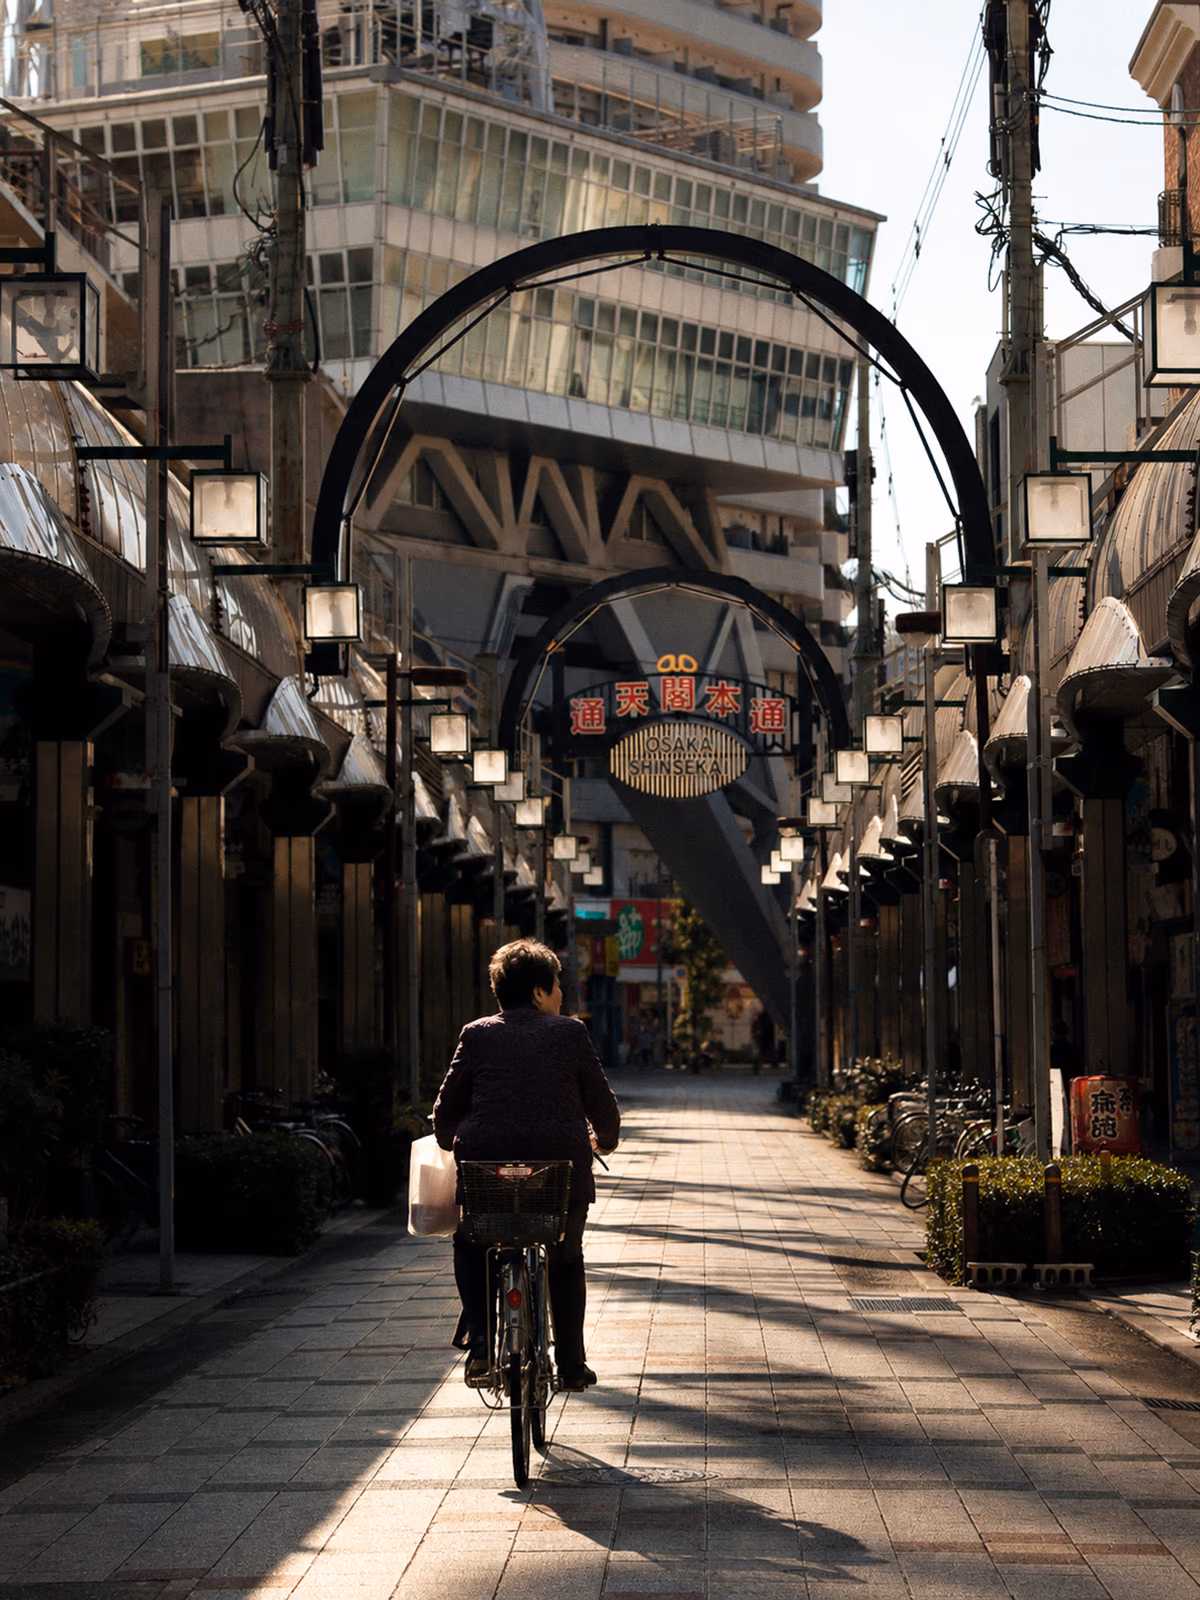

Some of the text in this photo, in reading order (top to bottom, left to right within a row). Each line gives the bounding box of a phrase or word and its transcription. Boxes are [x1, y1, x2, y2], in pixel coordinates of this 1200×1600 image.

[570, 676, 785, 734] 通天閣本通
[646, 737, 712, 753] OSAKA
[629, 760, 728, 775] SHINSEKAI
